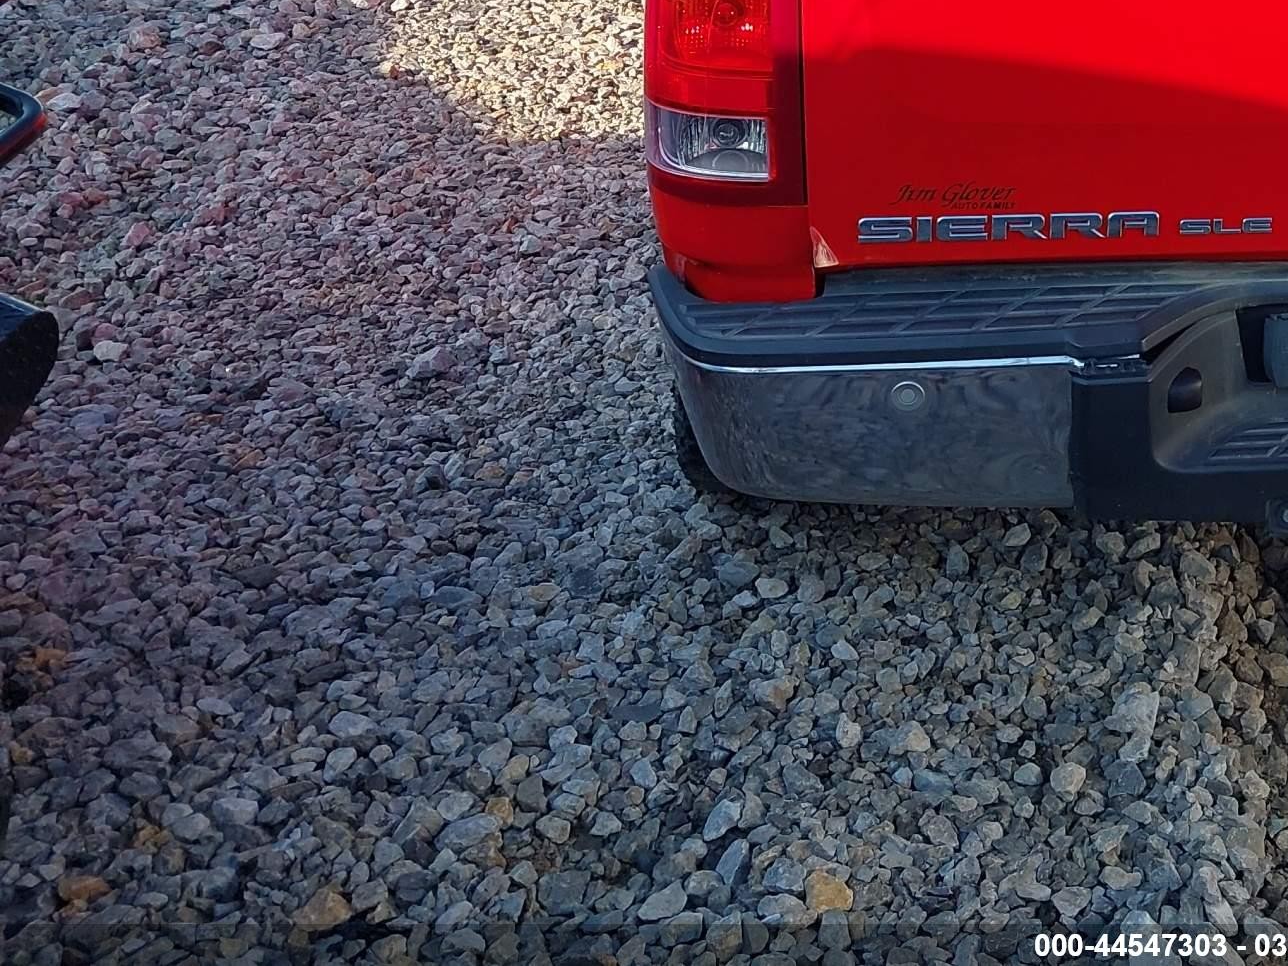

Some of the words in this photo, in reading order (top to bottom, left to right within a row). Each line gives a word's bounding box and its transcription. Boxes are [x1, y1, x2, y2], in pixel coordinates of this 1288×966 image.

[889, 184, 937, 205] Jim
[941, 180, 1017, 208] Glover
[858, 211, 1160, 243] SIERRA
[1179, 216, 1273, 235] SLE
